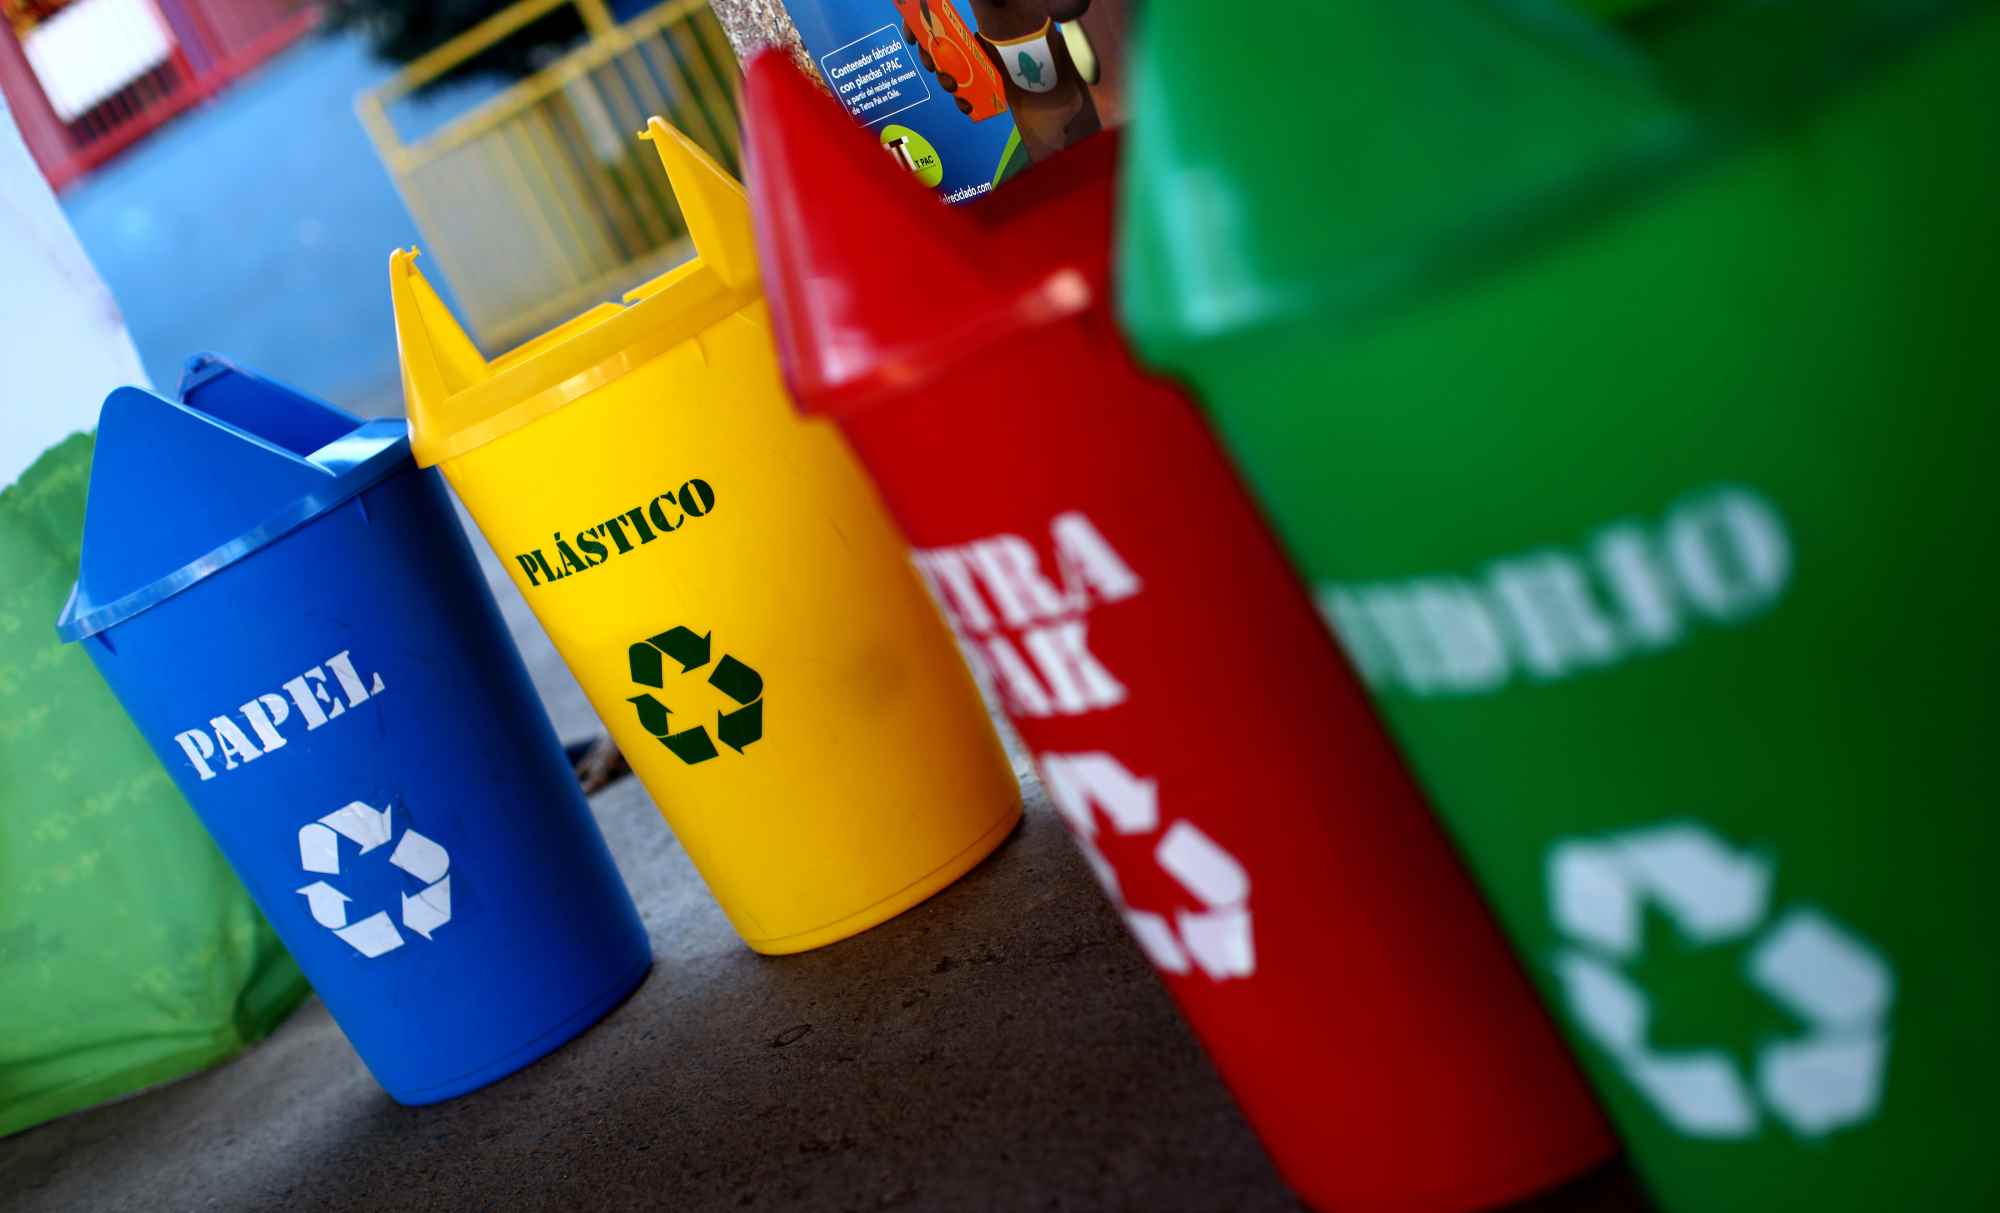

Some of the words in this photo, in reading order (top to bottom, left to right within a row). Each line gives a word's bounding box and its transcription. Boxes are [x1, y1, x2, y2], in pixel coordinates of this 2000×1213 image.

[831, 55, 872, 79] Contenedor
[871, 40, 902, 64] fabricado
[839, 80, 855, 94] con
[855, 69, 882, 89] planchas
[851, 91, 866, 107] partir
[866, 87, 875, 97] del
[890, 77, 898, 86] de
[897, 70, 917, 83] envases
[852, 107, 860, 115] de
[859, 99, 875, 113] Tetra
[873, 95, 883, 108] Pak
[920, 155, 934, 167] PAC
[515, 478, 715, 587] PLÁSTICO
[909, 509, 1141, 632] TRA
[968, 618, 1128, 719] AK
[174, 649, 385, 781] PAPEL
